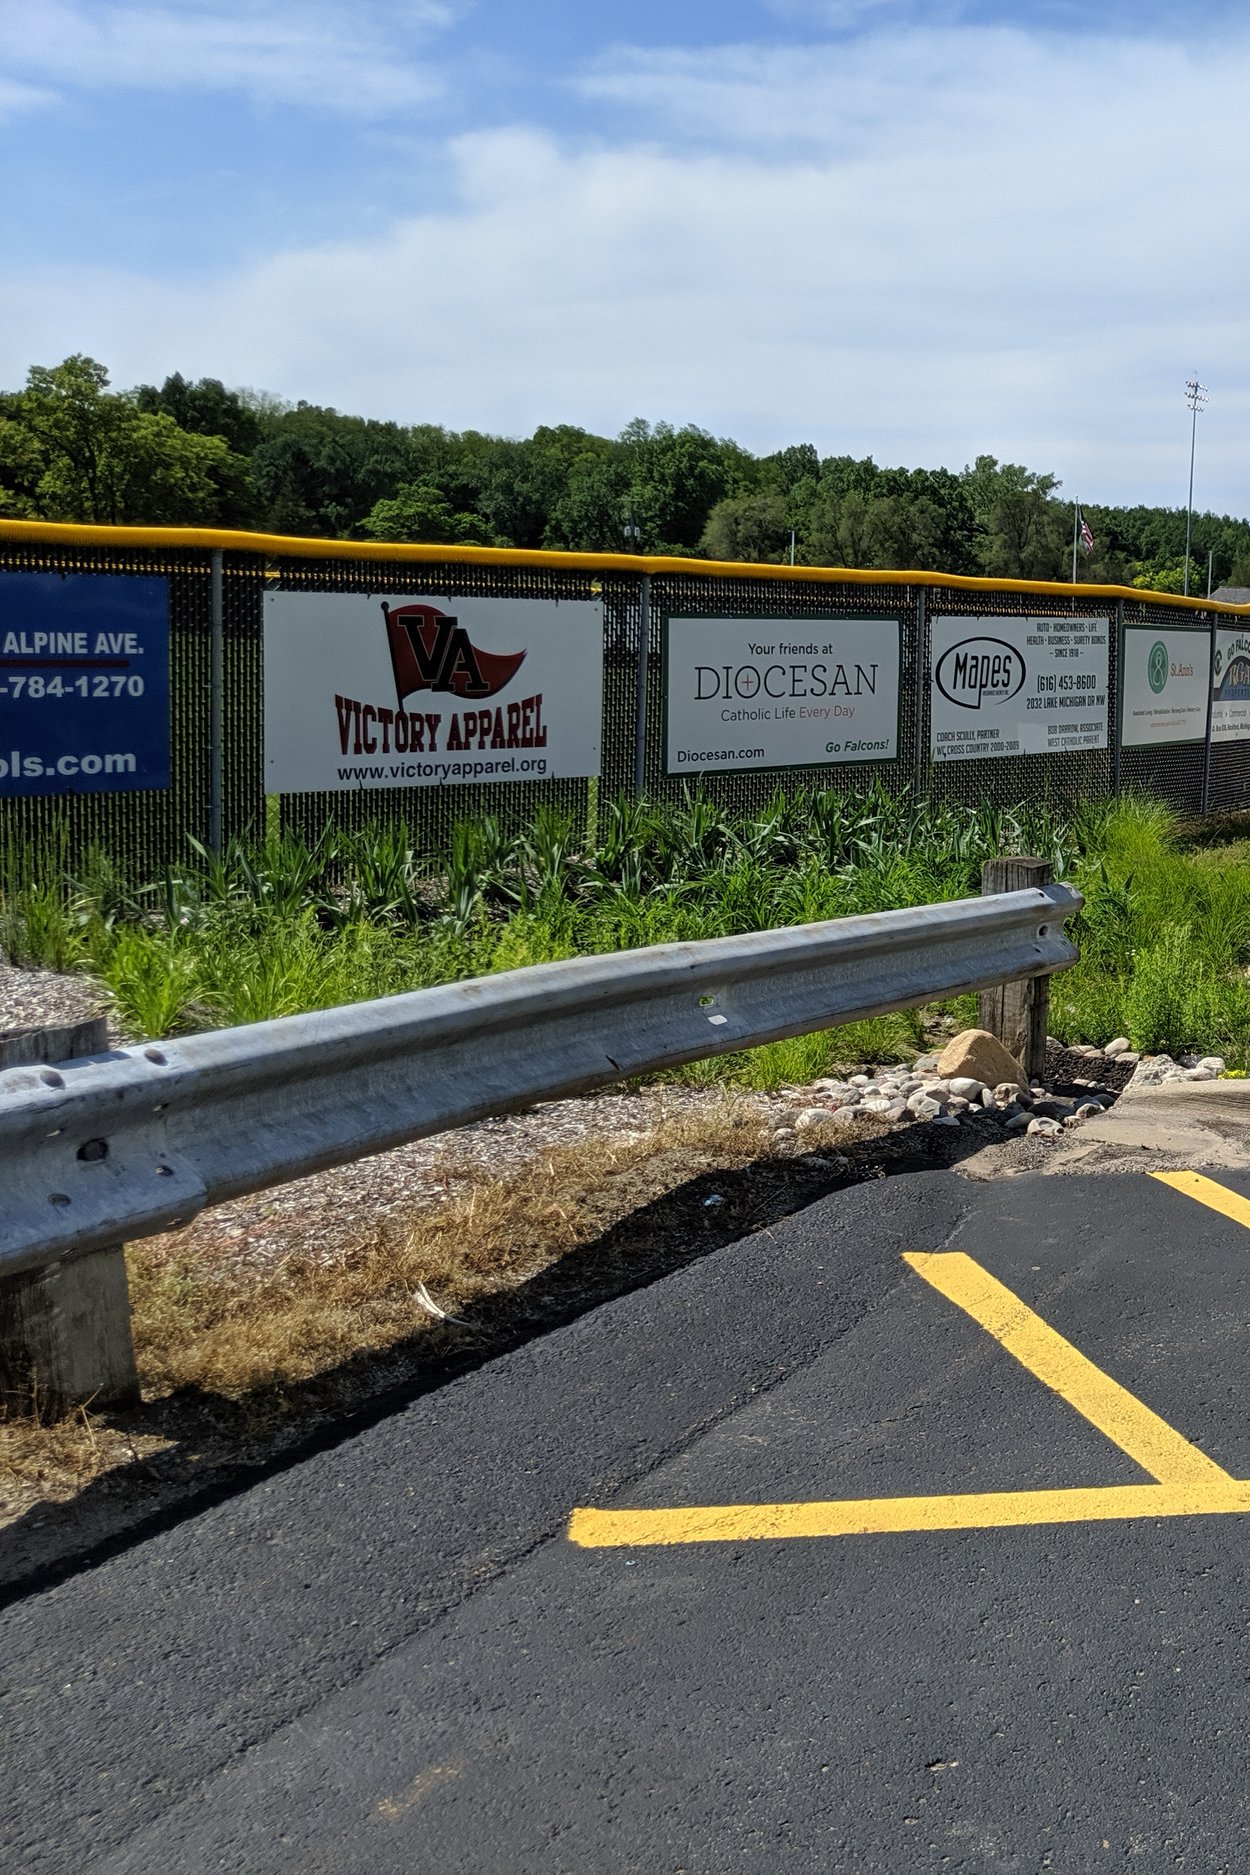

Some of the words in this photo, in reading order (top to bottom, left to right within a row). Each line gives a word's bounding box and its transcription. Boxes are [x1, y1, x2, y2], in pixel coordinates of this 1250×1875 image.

[1089, 623, 1098, 632] LIFE
[4, 632, 88, 654] ALPINE
[95, 633, 144, 654] AVE.
[748, 643, 775, 655] Your
[779, 643, 818, 654] friends
[822, 644, 833, 654] at
[397, 615, 490, 692] VA
[953, 652, 1012, 690] Mapes
[0, 676, 144, 698] -784-1270
[694, 664, 879, 700] DIOCESAN
[1038, 674, 1056, 693] (616)
[1059, 675, 1096, 690] 453-8600
[1027, 698, 1042, 709] 2032
[1044, 697, 1057, 708] LAKE
[1059, 696, 1086, 707] MICHIGAN
[1088, 695, 1095, 706] DR
[721, 707, 771, 722] Catholic
[774, 706, 796, 720] Life
[799, 706, 830, 720] Every
[834, 705, 855, 718] Day
[335, 694, 441, 755] VICTORY
[447, 694, 547, 751] APPAREL
[677, 746, 765, 763] Diocesan.com
[825, 741, 841, 753] Go
[844, 739, 889, 752] Falcons!
[338, 757, 547, 781] www.victoryapparel.org
